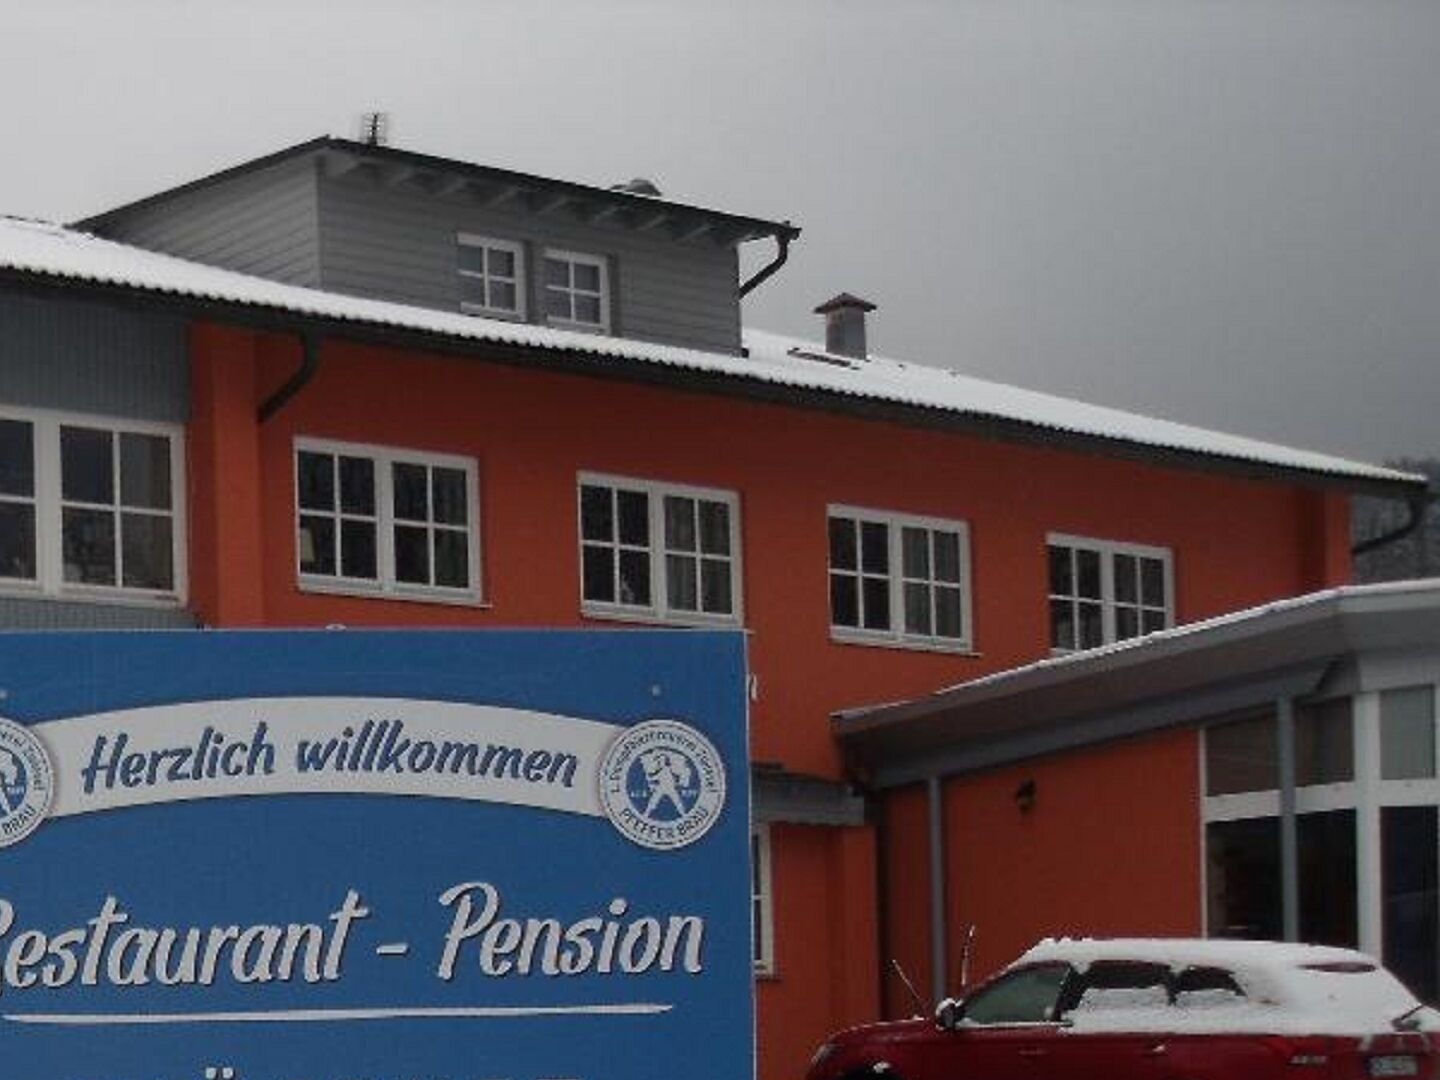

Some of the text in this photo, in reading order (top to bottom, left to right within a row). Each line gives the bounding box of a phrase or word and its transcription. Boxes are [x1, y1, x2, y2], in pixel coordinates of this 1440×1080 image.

[81, 718, 578, 795] Herzlich willkommen
[437, 880, 704, 981] Pension
